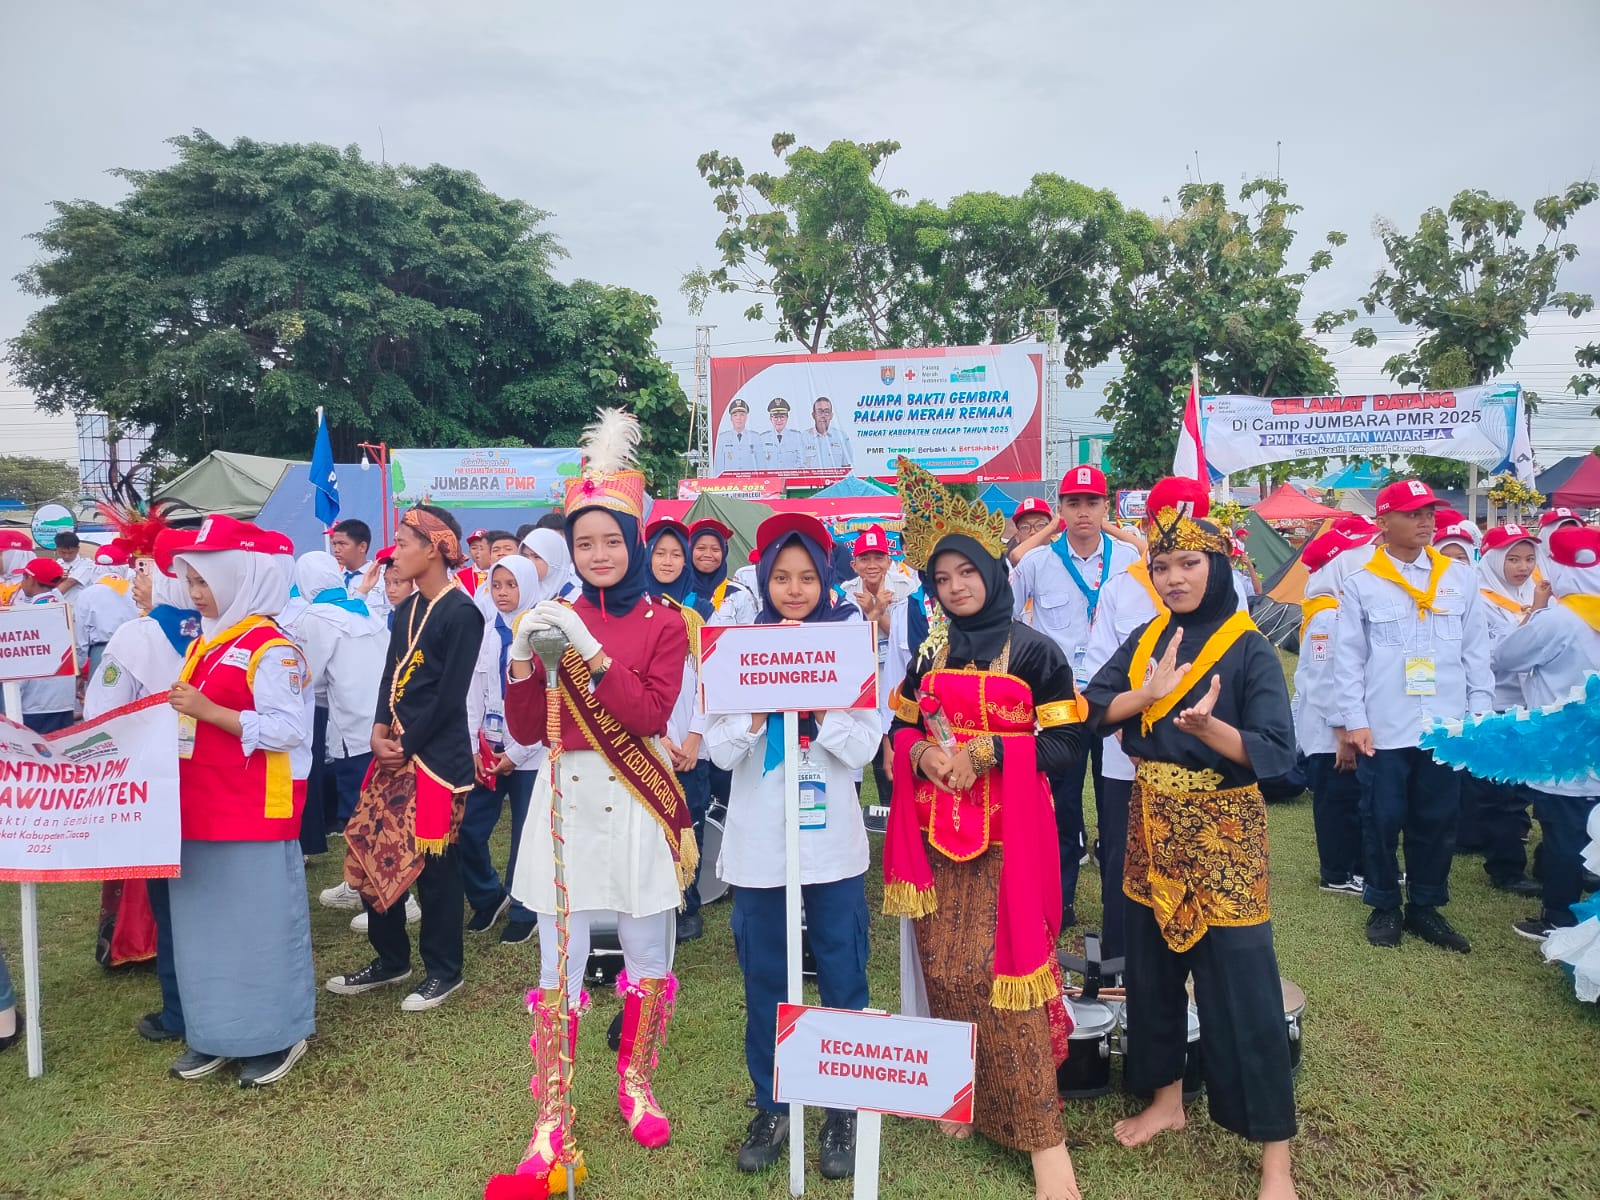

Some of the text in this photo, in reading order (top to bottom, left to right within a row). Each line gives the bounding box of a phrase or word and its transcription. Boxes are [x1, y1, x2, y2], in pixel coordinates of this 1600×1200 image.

[856, 390, 1010, 407] JUMPA BAKTI GEMBIRA
[1272, 391, 1456, 415] SELAMAT DATANG
[854, 406, 1013, 422] PALANG MERAH REMAJA
[1232, 410, 1482, 433] Di Camp JUMBARA PMR 2025
[856, 426, 1009, 438] TINGKAT KABUPATEN CILACAP TAHUN 2025
[1266, 428, 1446, 446] PMI KECAMATAN WANAREJA
[430, 476, 536, 490] JUMBARA PMR
[740, 650, 836, 666] KECAMATAN
[740, 669, 838, 686] KEDUNGREJA
[594, 708, 622, 735] SMP
[610, 731, 630, 748] N
[618, 744, 636, 757] 1
[101, 758, 130, 781] PMI
[623, 748, 678, 818] KEDUNGREJA
[0, 816, 26, 826] kti
[34, 817, 59, 827] dan
[111, 812, 142, 823] PMR
[26, 844, 52, 854] 2025
[820, 1039, 928, 1065] KECAMATAN
[818, 1061, 929, 1087] KEDUNGREJA
